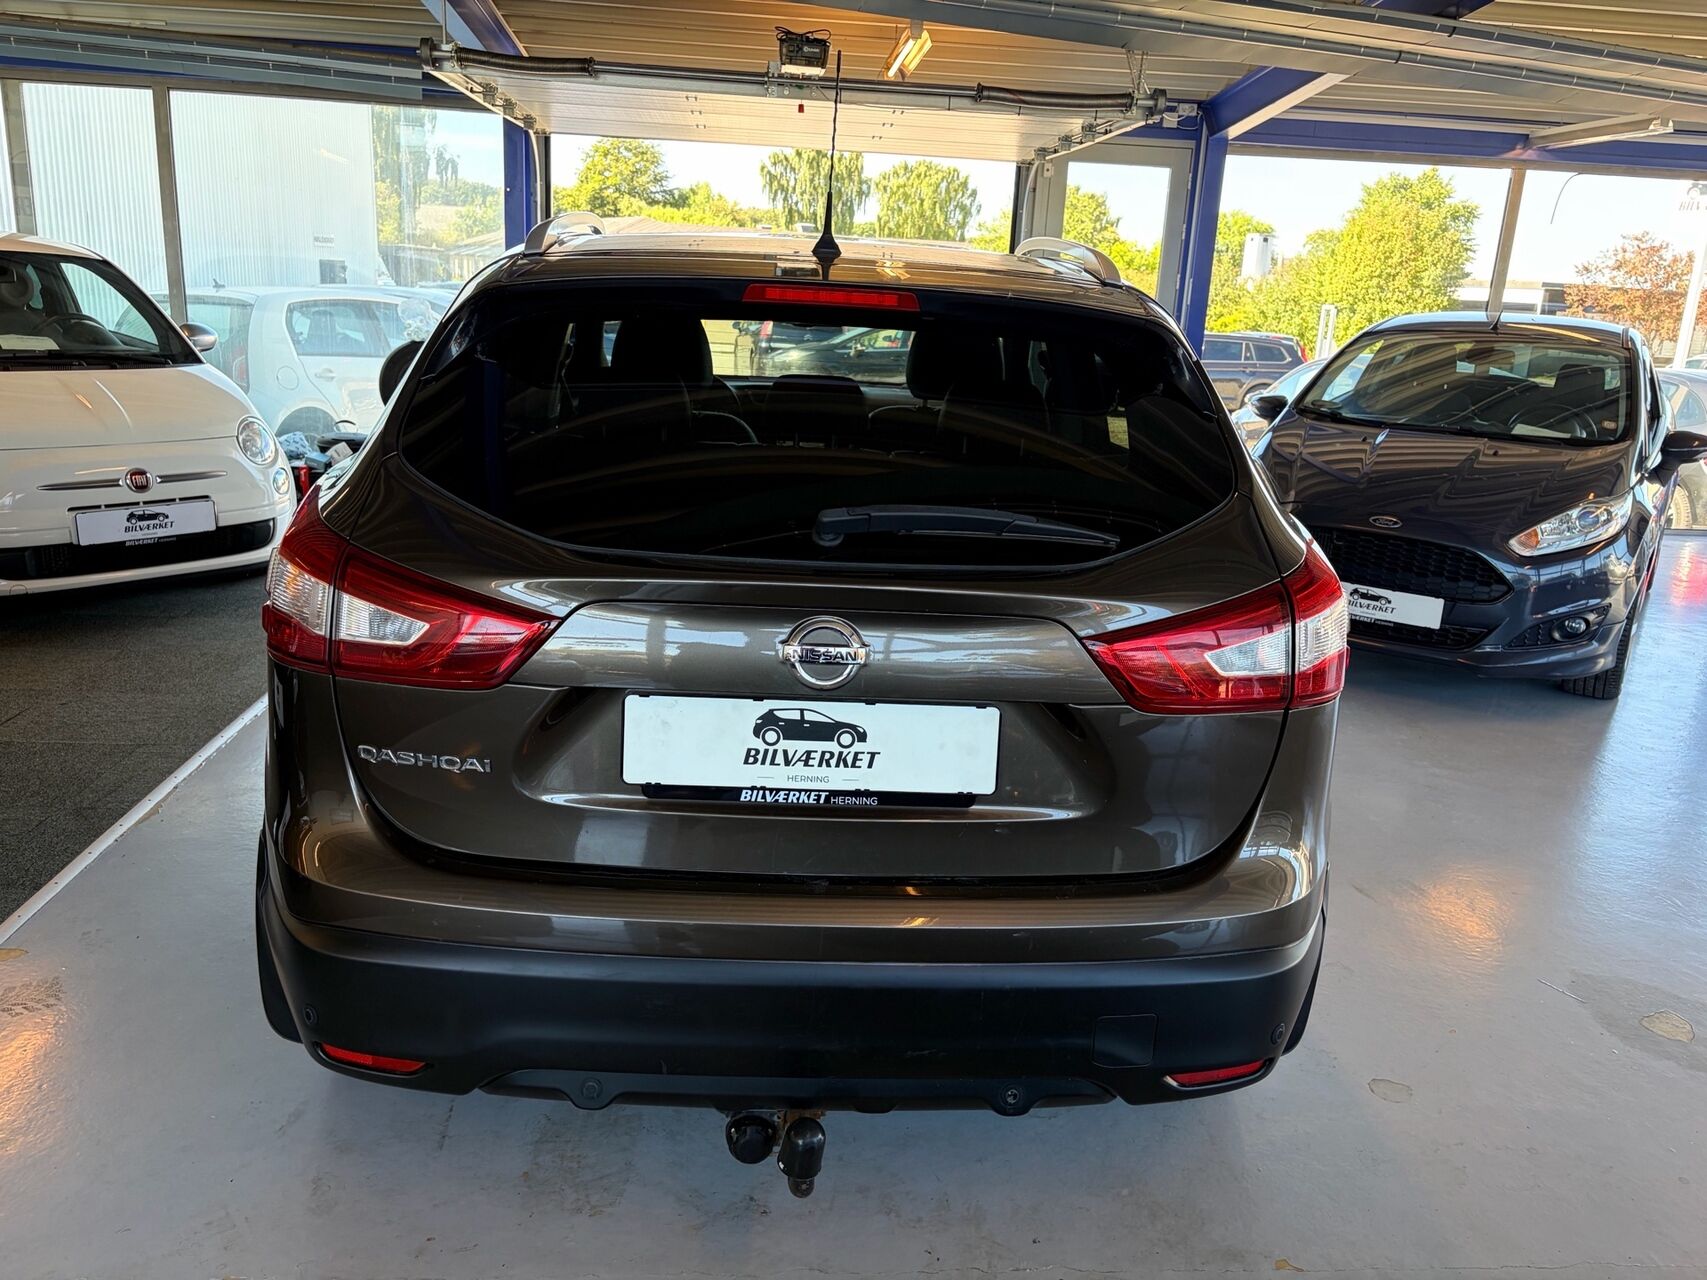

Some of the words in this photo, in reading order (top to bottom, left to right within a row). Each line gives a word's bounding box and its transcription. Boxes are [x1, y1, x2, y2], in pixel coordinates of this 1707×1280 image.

[132, 473, 148, 487] FIAT
[124, 520, 175, 533] BILVÆRKET
[792, 647, 858, 662] NISSAN
[742, 747, 881, 769] BILVÆRKET
[786, 773, 830, 784] HERNING
[739, 788, 829, 804] BILVÆRKET
[830, 795, 878, 807] HERNING
